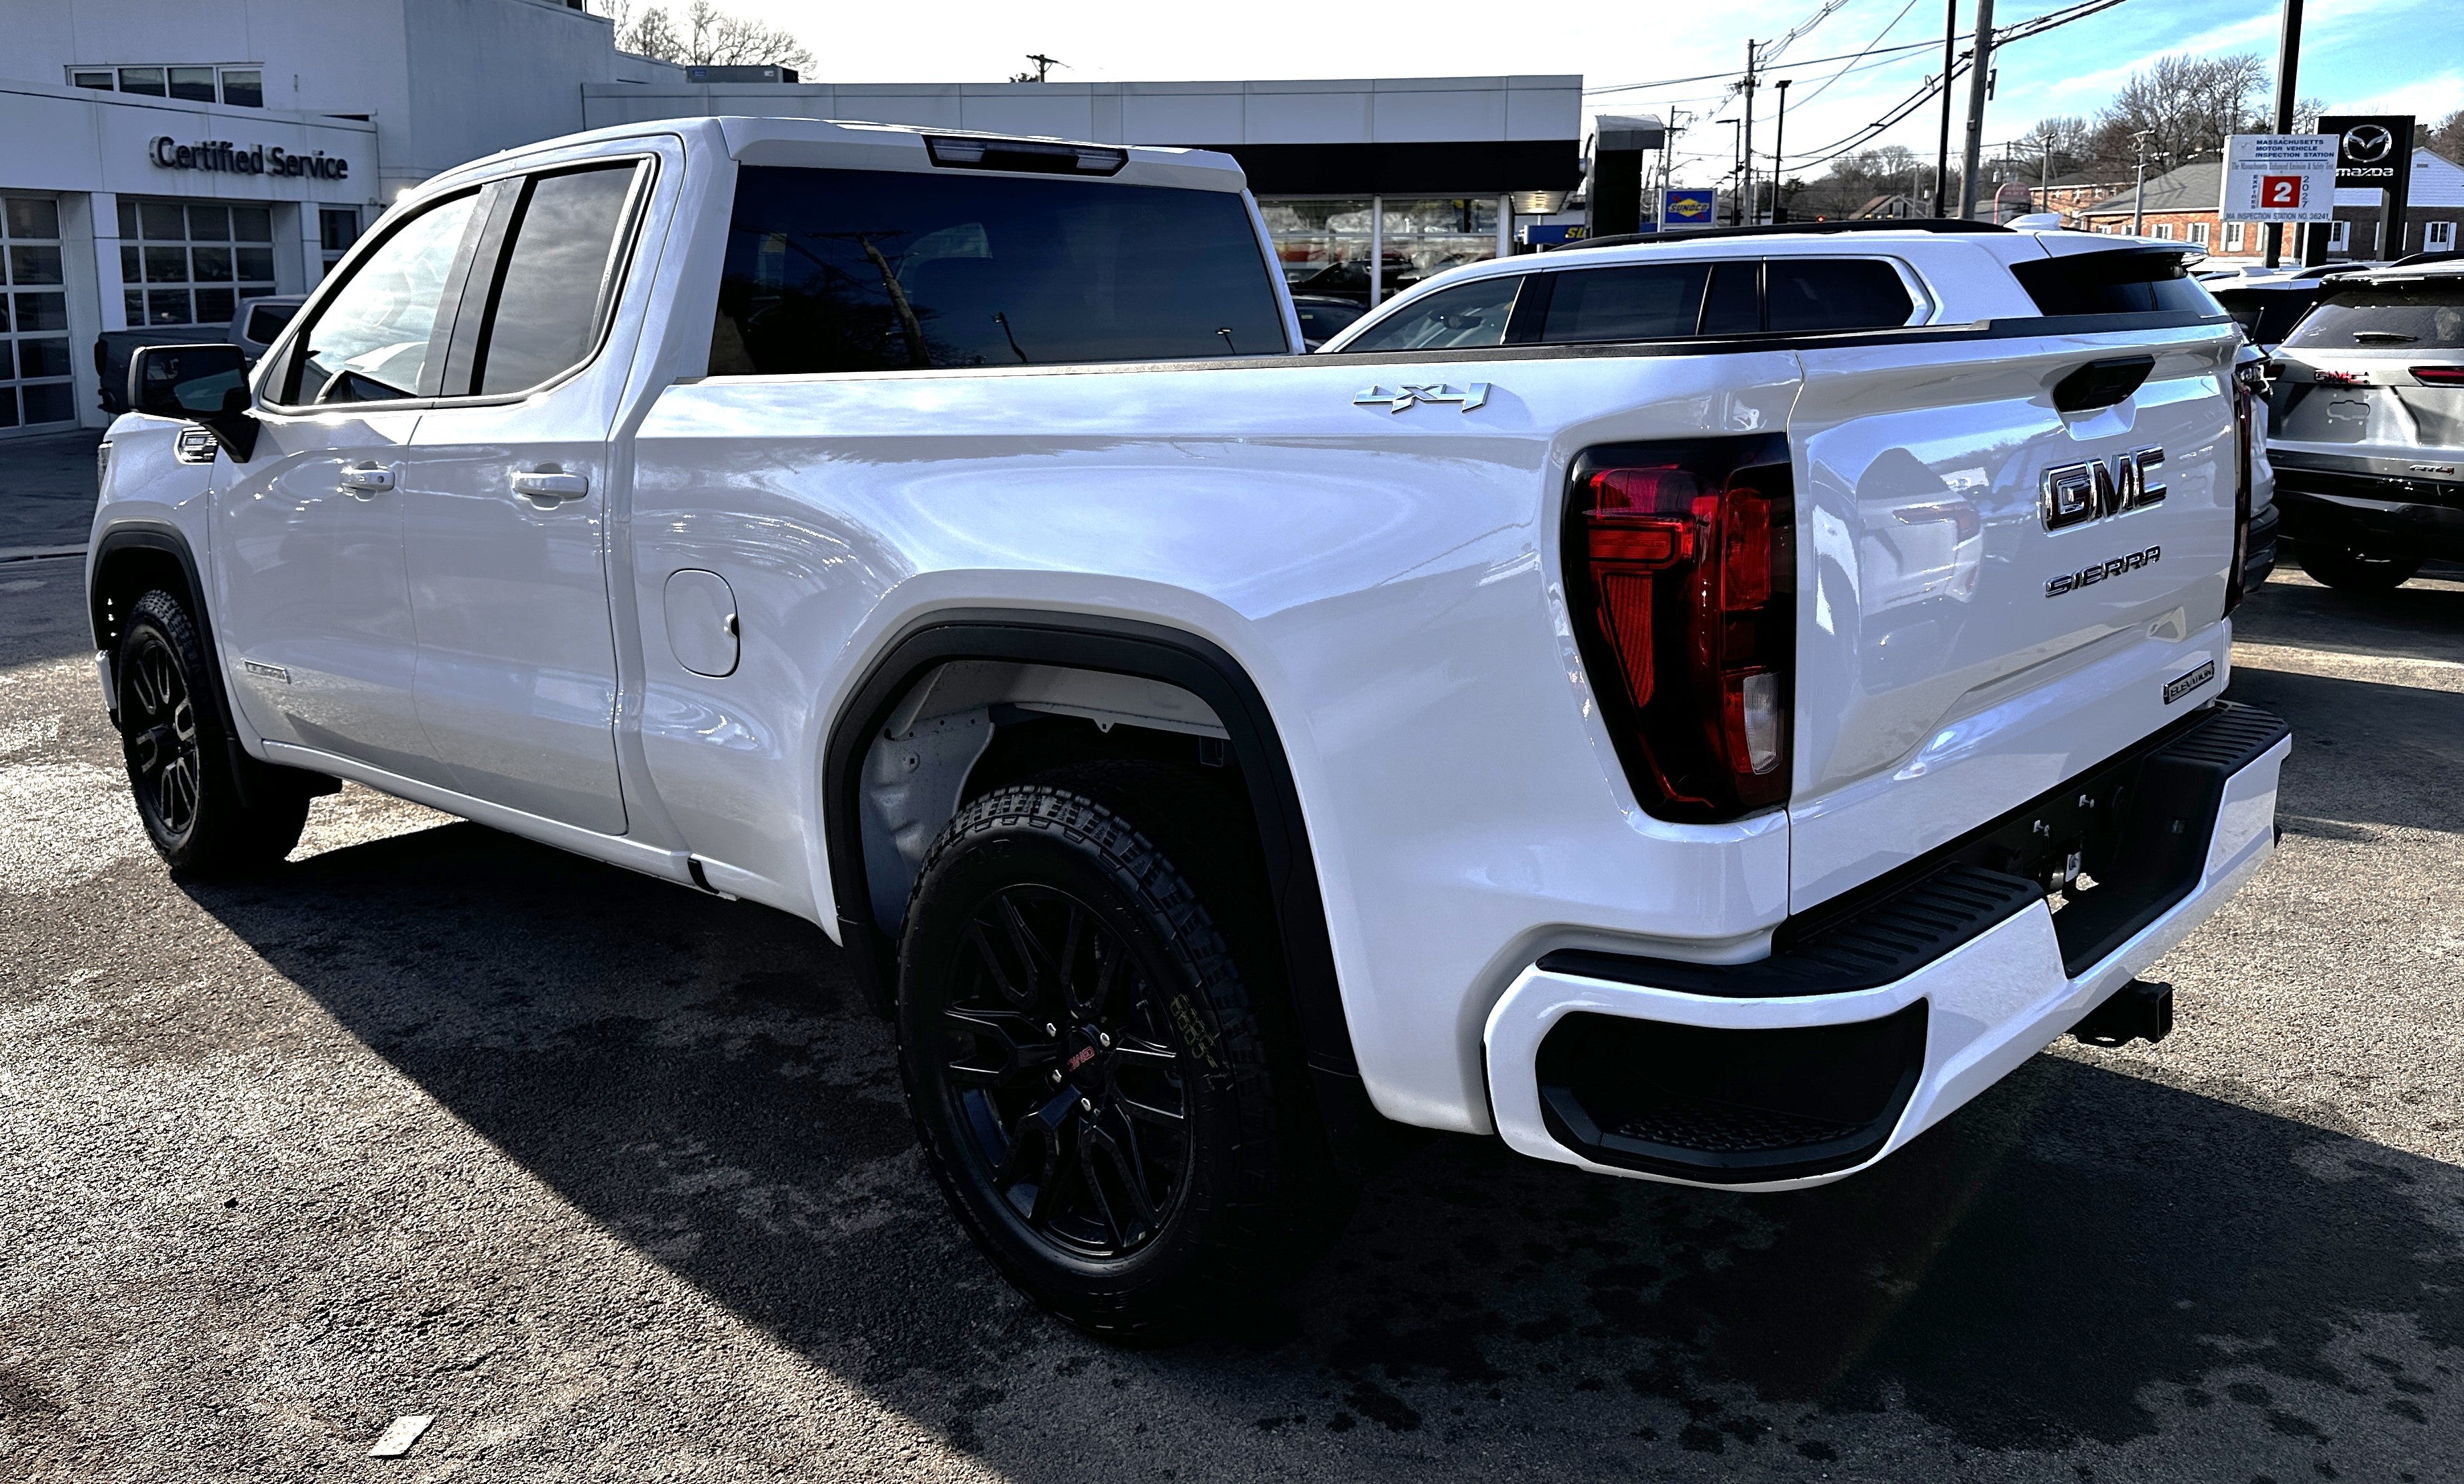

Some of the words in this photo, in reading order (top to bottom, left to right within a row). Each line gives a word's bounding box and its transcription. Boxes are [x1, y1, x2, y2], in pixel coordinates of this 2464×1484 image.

[152, 135, 264, 174] Certified
[269, 146, 349, 179] Service
[2335, 168, 2394, 176] mazda
[2273, 181, 2292, 202] 2
[2040, 446, 2167, 532] GMC
[2044, 544, 2161, 597] SIERRA
[1066, 1046, 1095, 1072] GMC
